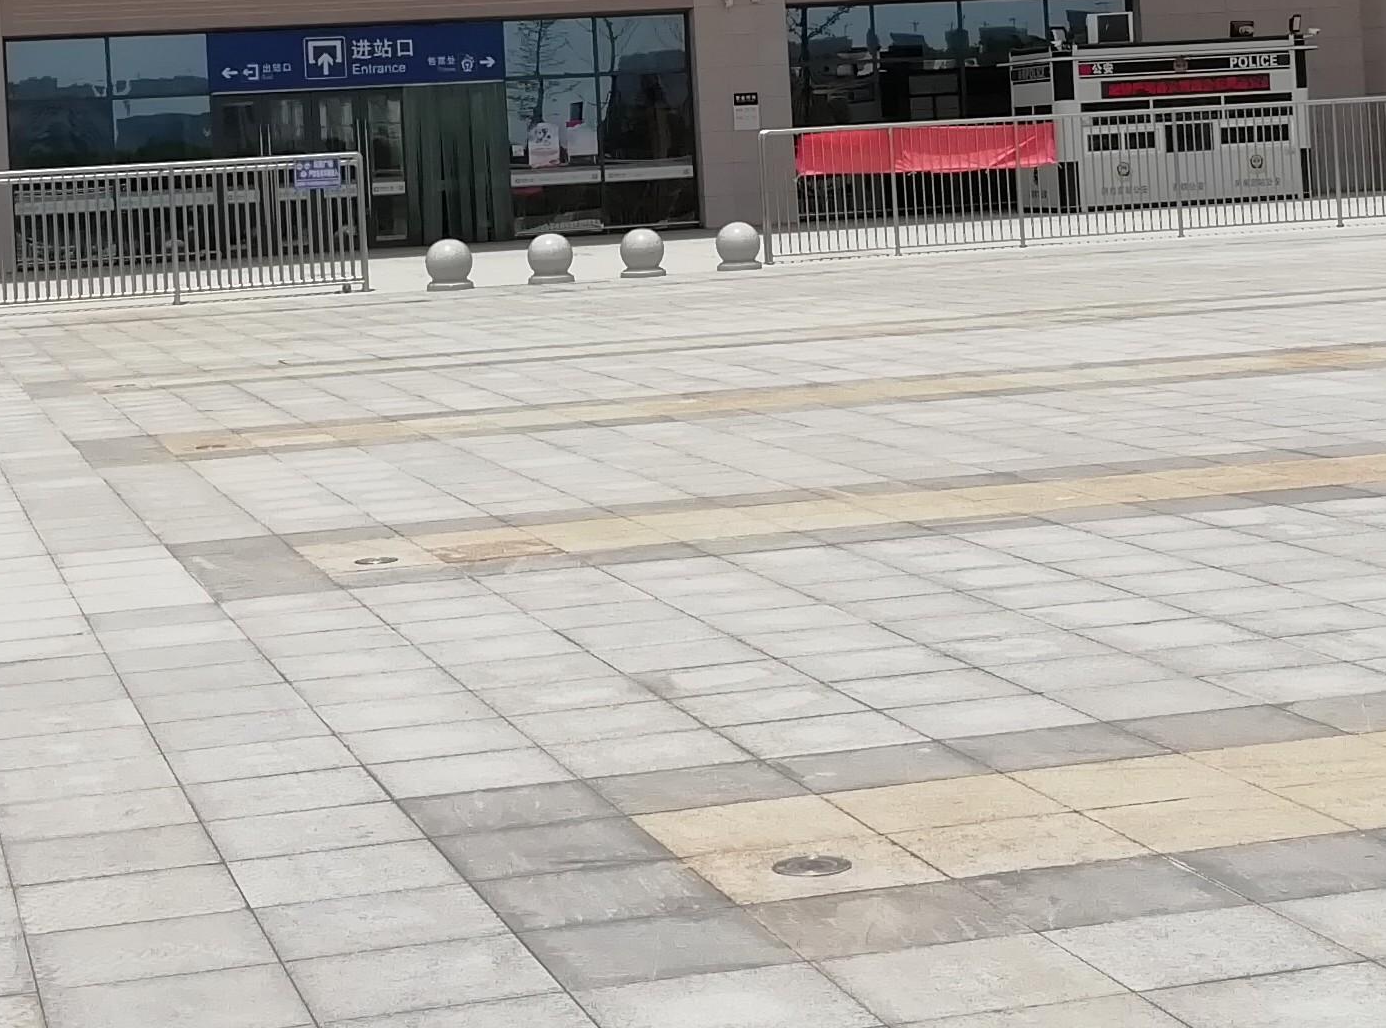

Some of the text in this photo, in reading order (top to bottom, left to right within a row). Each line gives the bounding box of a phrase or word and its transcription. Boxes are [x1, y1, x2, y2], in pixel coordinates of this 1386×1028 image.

[351, 38, 414, 59] 进站口
[1091, 62, 1114, 74] 公安
[1229, 54, 1278, 69] POLICE
[352, 64, 406, 75] Entrance
